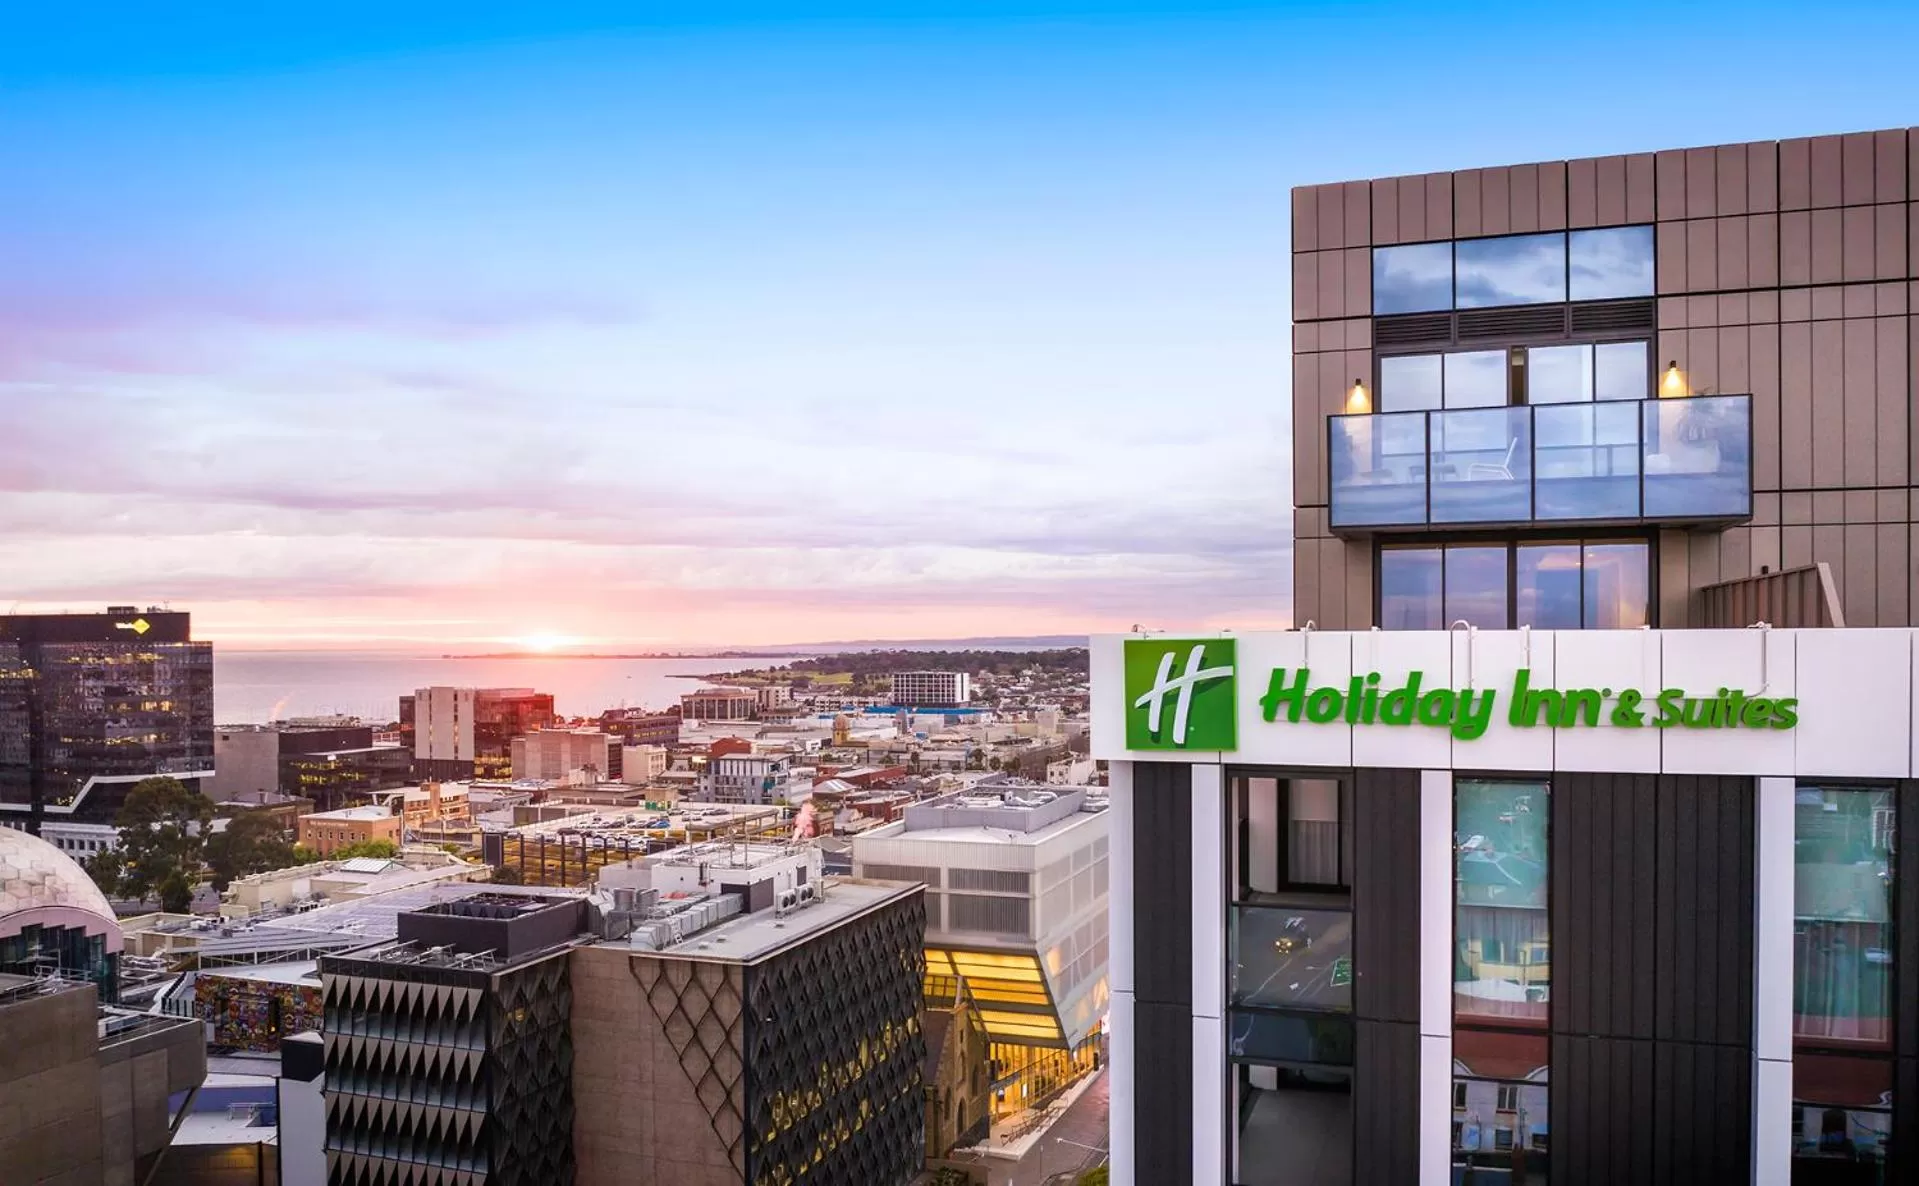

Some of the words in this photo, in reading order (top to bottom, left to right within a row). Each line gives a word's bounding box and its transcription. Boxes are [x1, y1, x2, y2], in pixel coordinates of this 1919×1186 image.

[1134, 644, 1234, 744] H
[1260, 667, 1496, 741] Holiday
[1508, 668, 1601, 728] Inn
[1610, 688, 1646, 727] &
[1652, 687, 1798, 729] Suites
